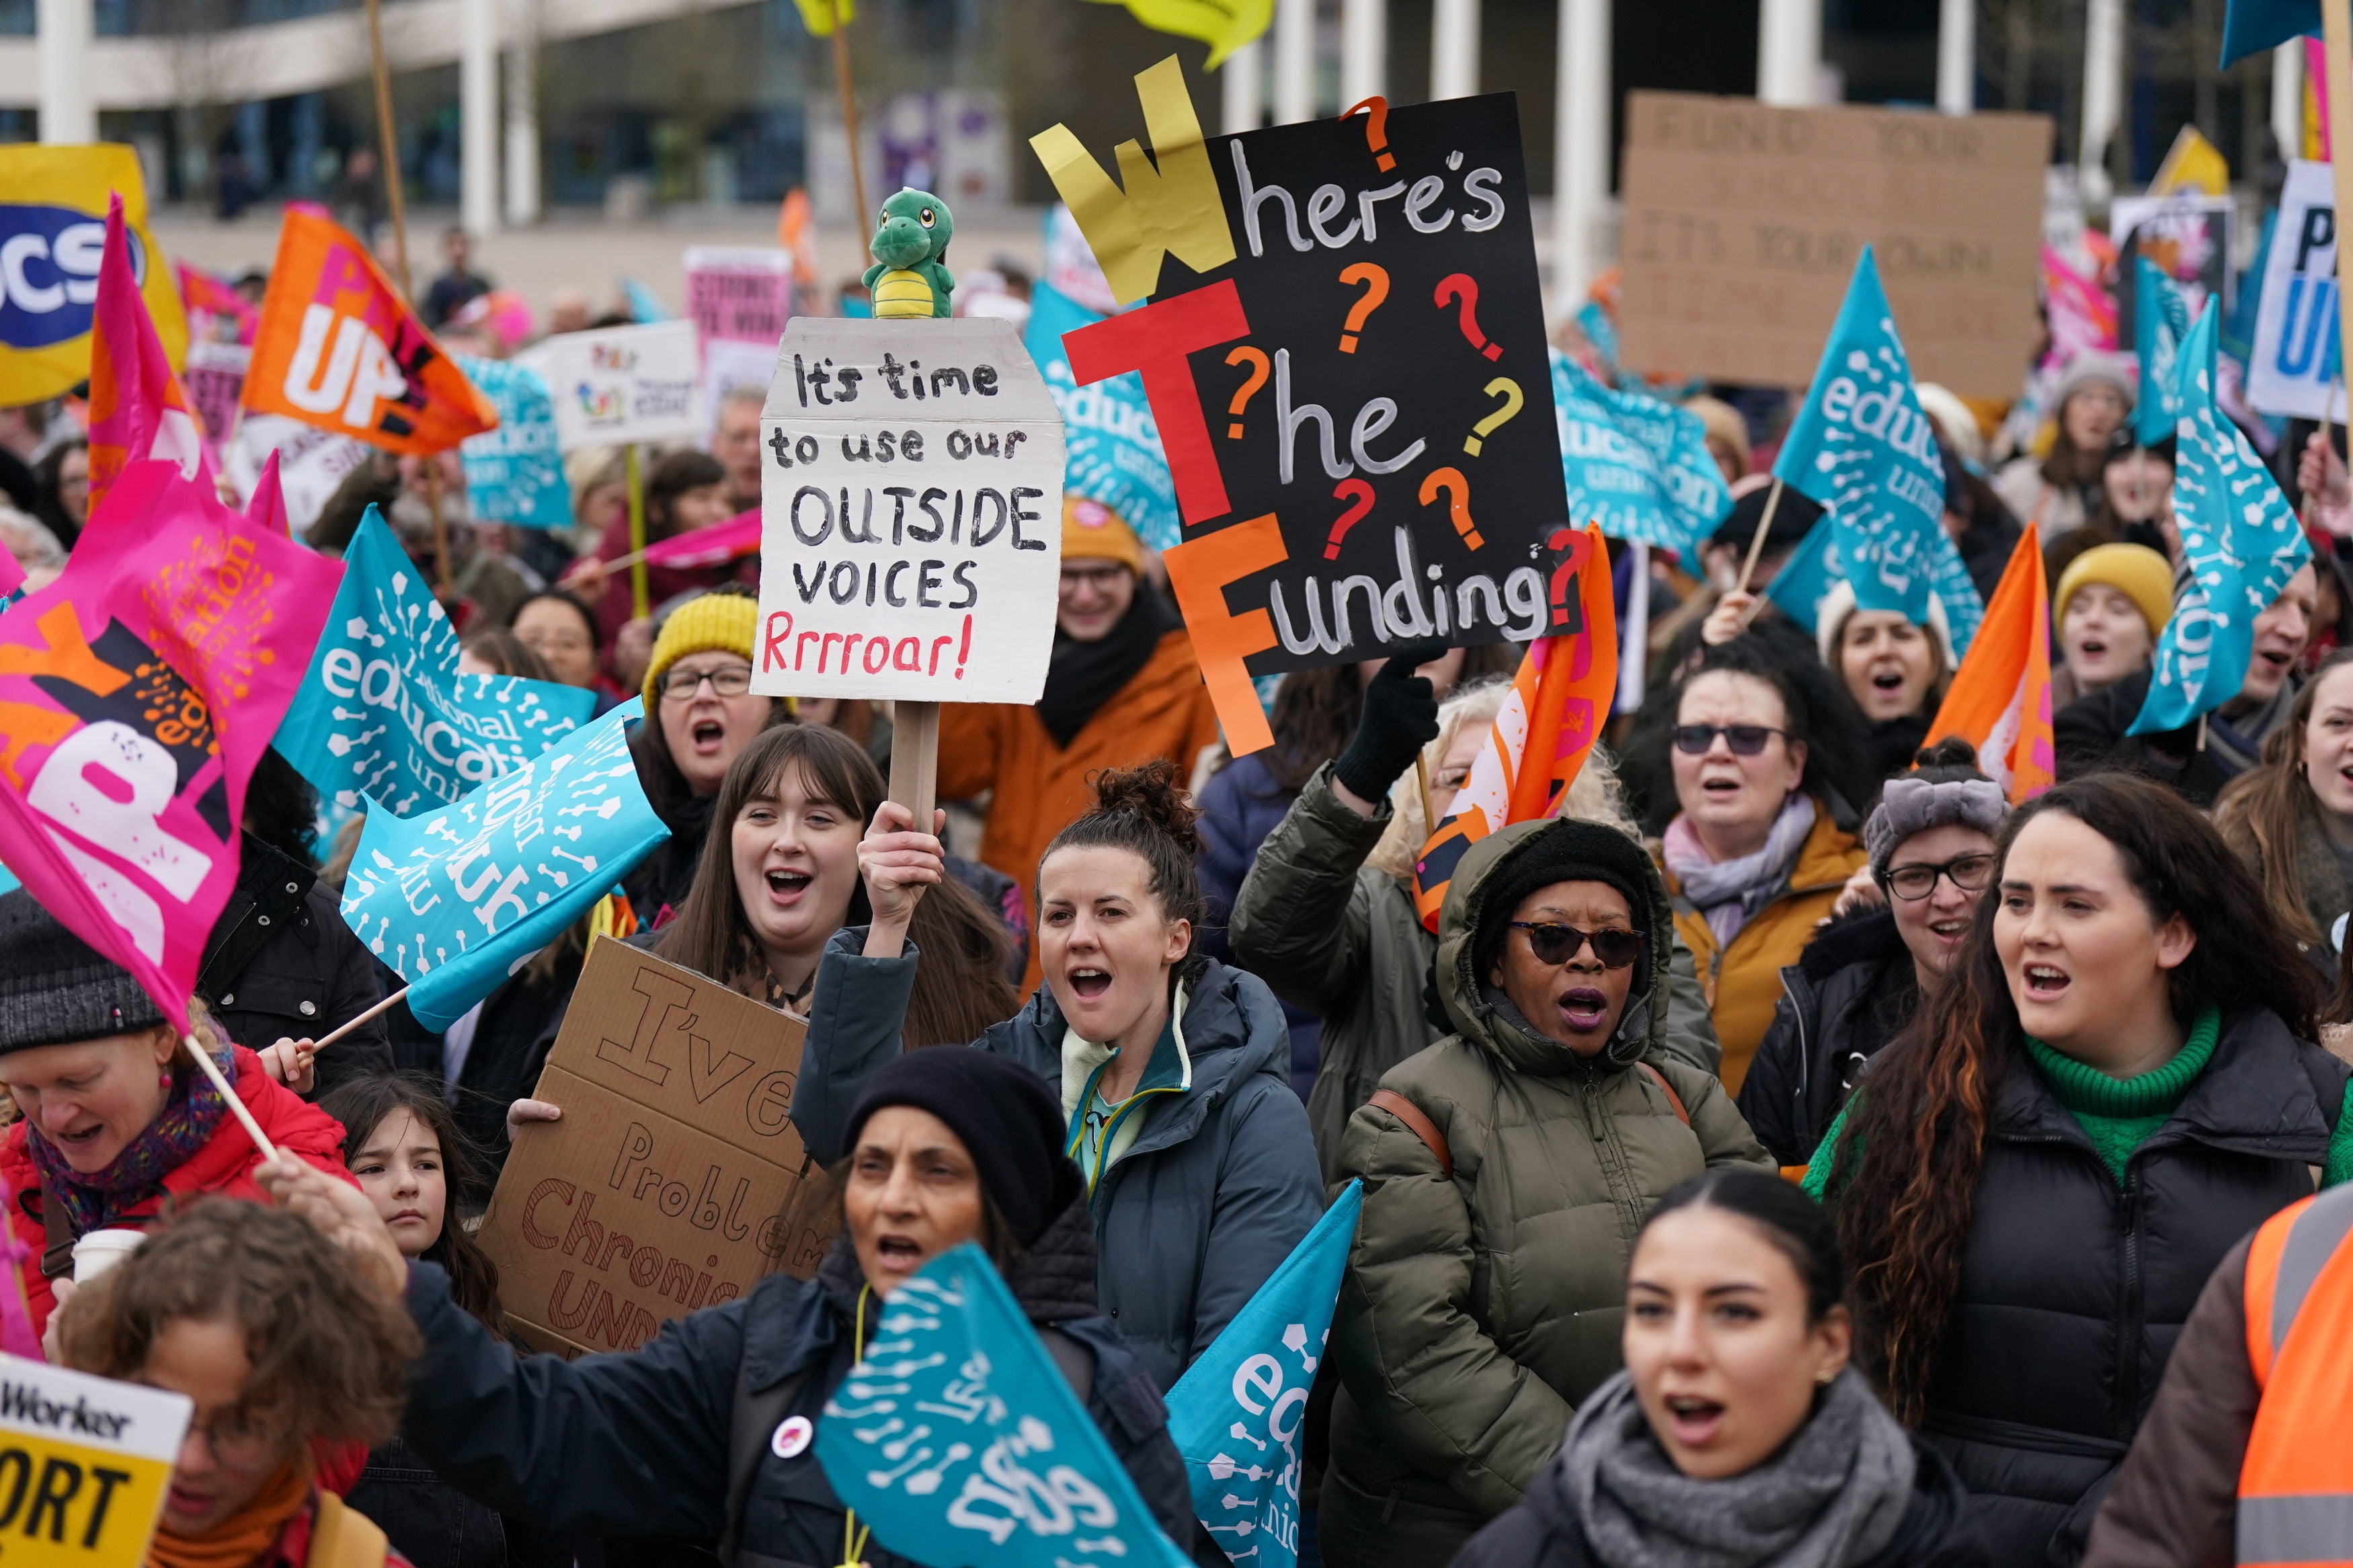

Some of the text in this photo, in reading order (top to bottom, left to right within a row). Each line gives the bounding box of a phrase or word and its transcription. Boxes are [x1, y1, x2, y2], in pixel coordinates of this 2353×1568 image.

[1029, 53, 1505, 306] Where's
[0, 222, 106, 315] CS
[794, 353, 999, 407] It's time
[1060, 278, 1427, 527] The
[768, 427, 1027, 468] to use our
[790, 485, 1047, 551] OUTSIDE
[793, 559, 978, 609] VOICES
[762, 610, 973, 680] Rrrroar!
[596, 966, 798, 1137] I've
[1, 1380, 132, 1440] Worker
